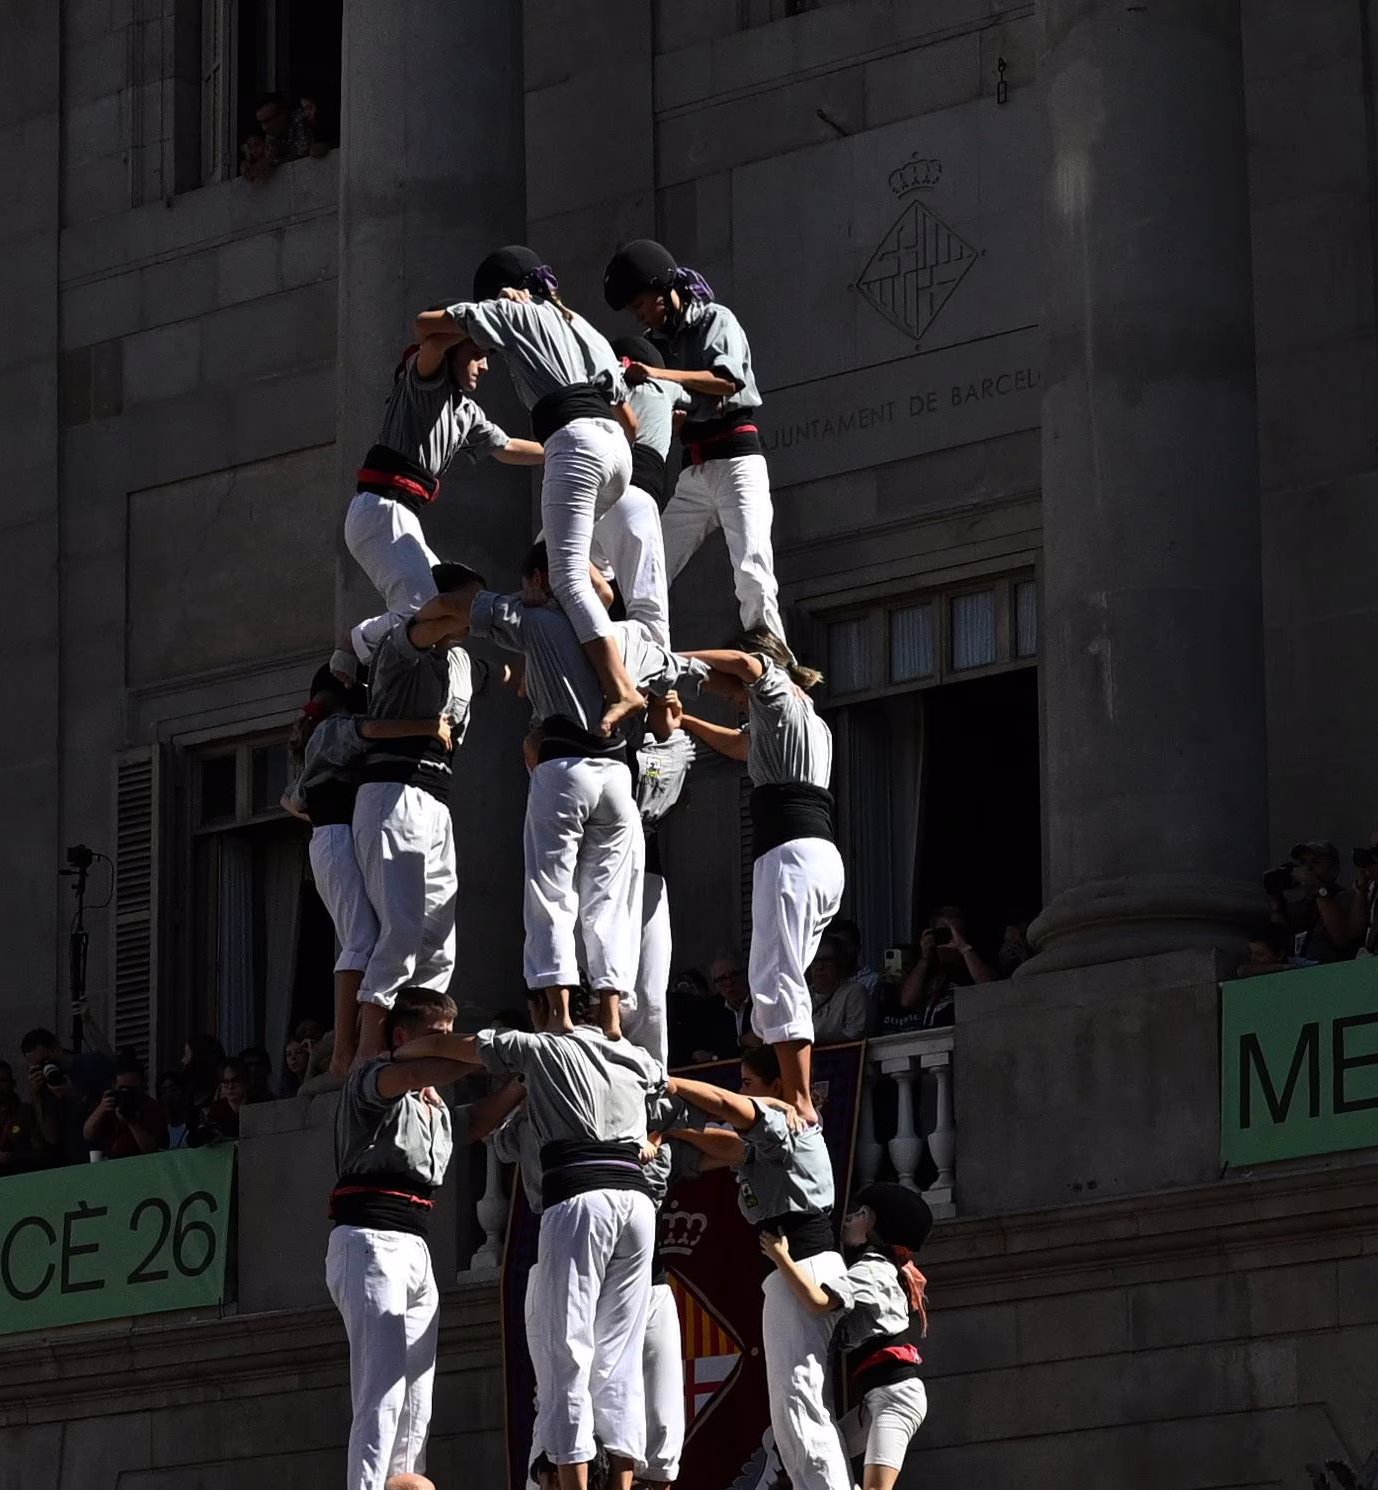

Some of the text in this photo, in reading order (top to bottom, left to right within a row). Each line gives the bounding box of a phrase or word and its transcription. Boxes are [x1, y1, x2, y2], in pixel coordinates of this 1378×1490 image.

[909, 391, 938, 418] DE
[951, 368, 1041, 407] BARCEL
[126, 1190, 218, 1285] 26
